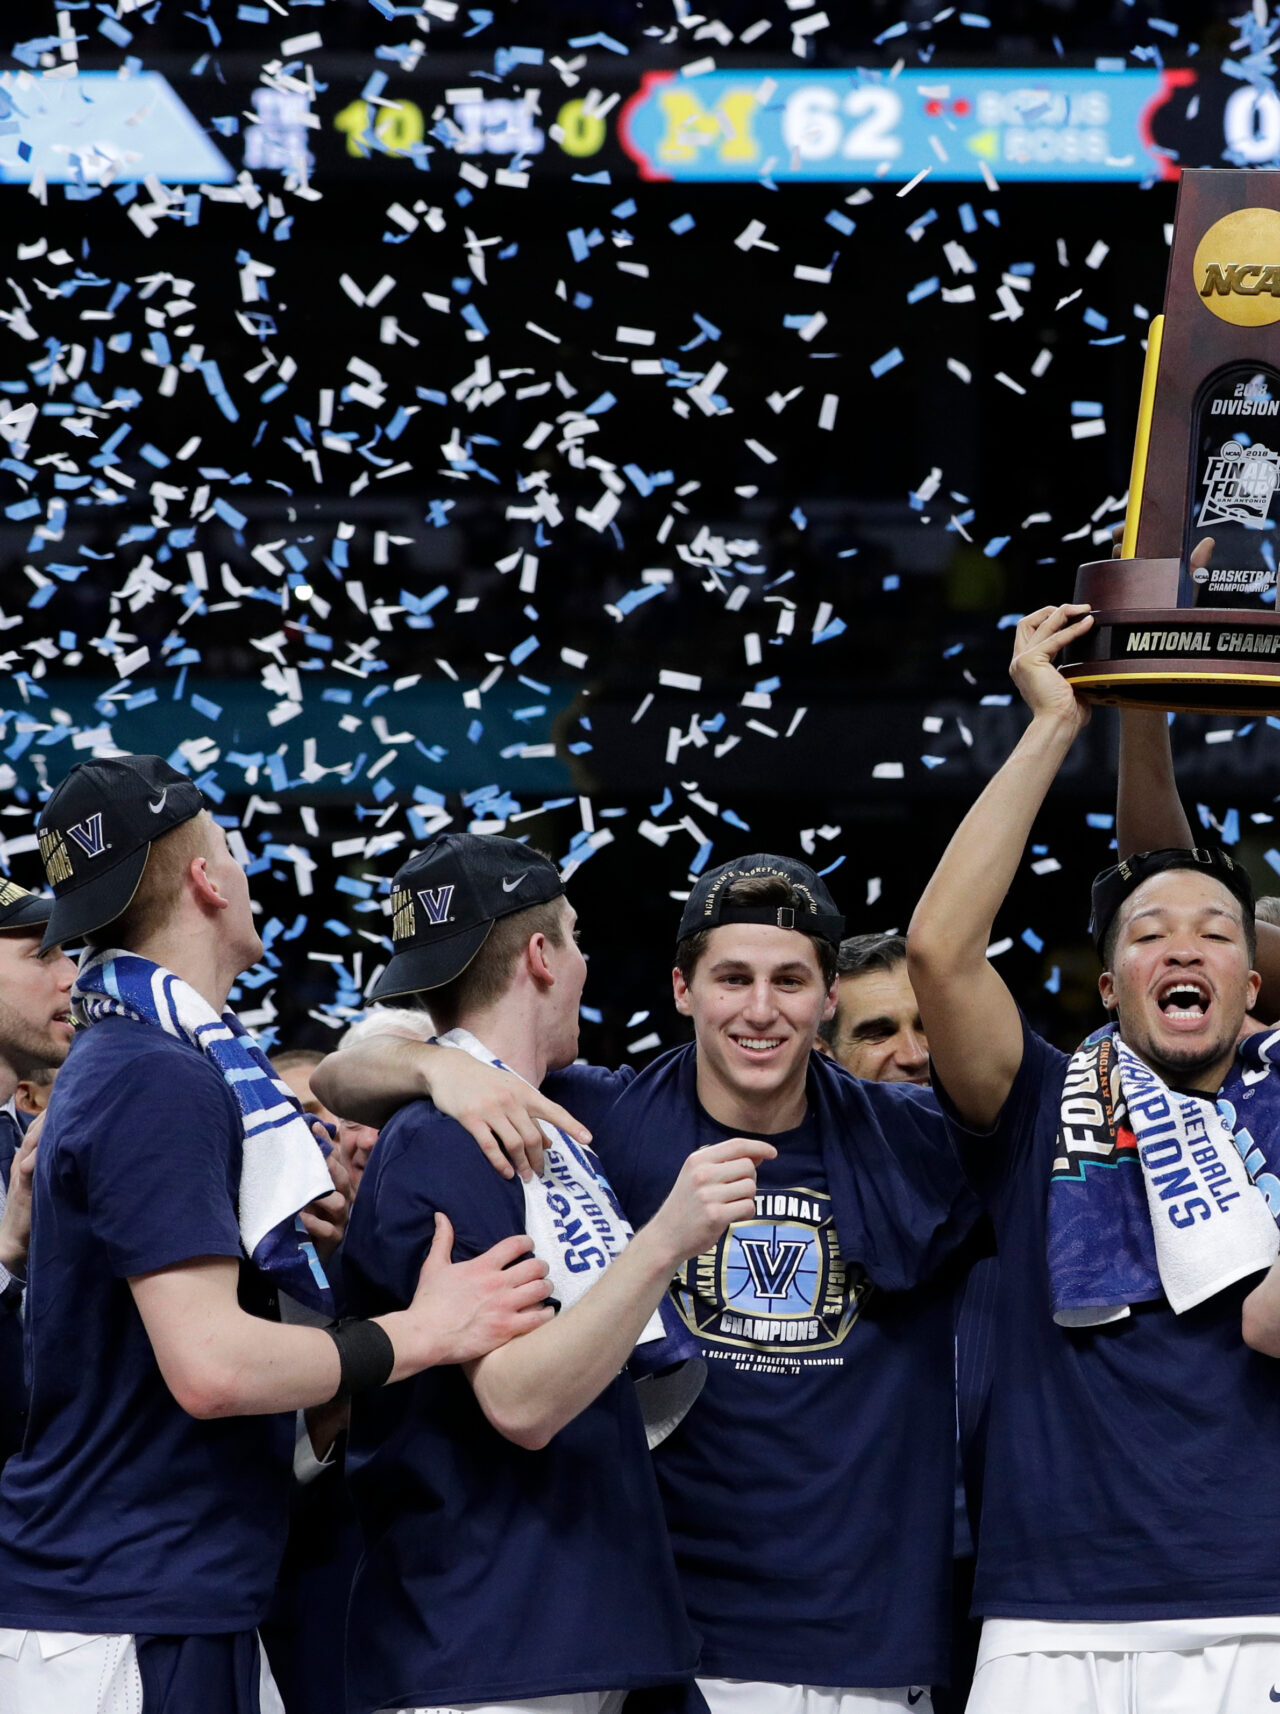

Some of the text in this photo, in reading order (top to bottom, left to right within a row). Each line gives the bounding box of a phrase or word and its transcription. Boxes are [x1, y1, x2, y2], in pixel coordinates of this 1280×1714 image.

[781, 87, 902, 162] 62
[1211, 400, 1280, 416] DIVISION
[1207, 460, 1269, 481] FINAL
[1210, 481, 1268, 499] FOUR
[1208, 582, 1271, 593] CHAMPIONSHIP
[1211, 570, 1277, 583] BASKETBAL
[1126, 631, 1211, 652] NATIONAL
[66, 811, 105, 858] V
[417, 884, 455, 925] V
[1061, 1045, 1115, 1155] FOUR
[754, 1195, 821, 1222] TIONAL
[740, 1239, 808, 1299] V
[822, 1229, 846, 1315] WILDCATS
[719, 1313, 819, 1342] CHAMPIONS
[735, 1361, 751, 1371] SAN
[791, 1366, 801, 1375] TX
[756, 1355, 802, 1366] BASKETBALL
[803, 1357, 844, 1366] CHAMPIONS
